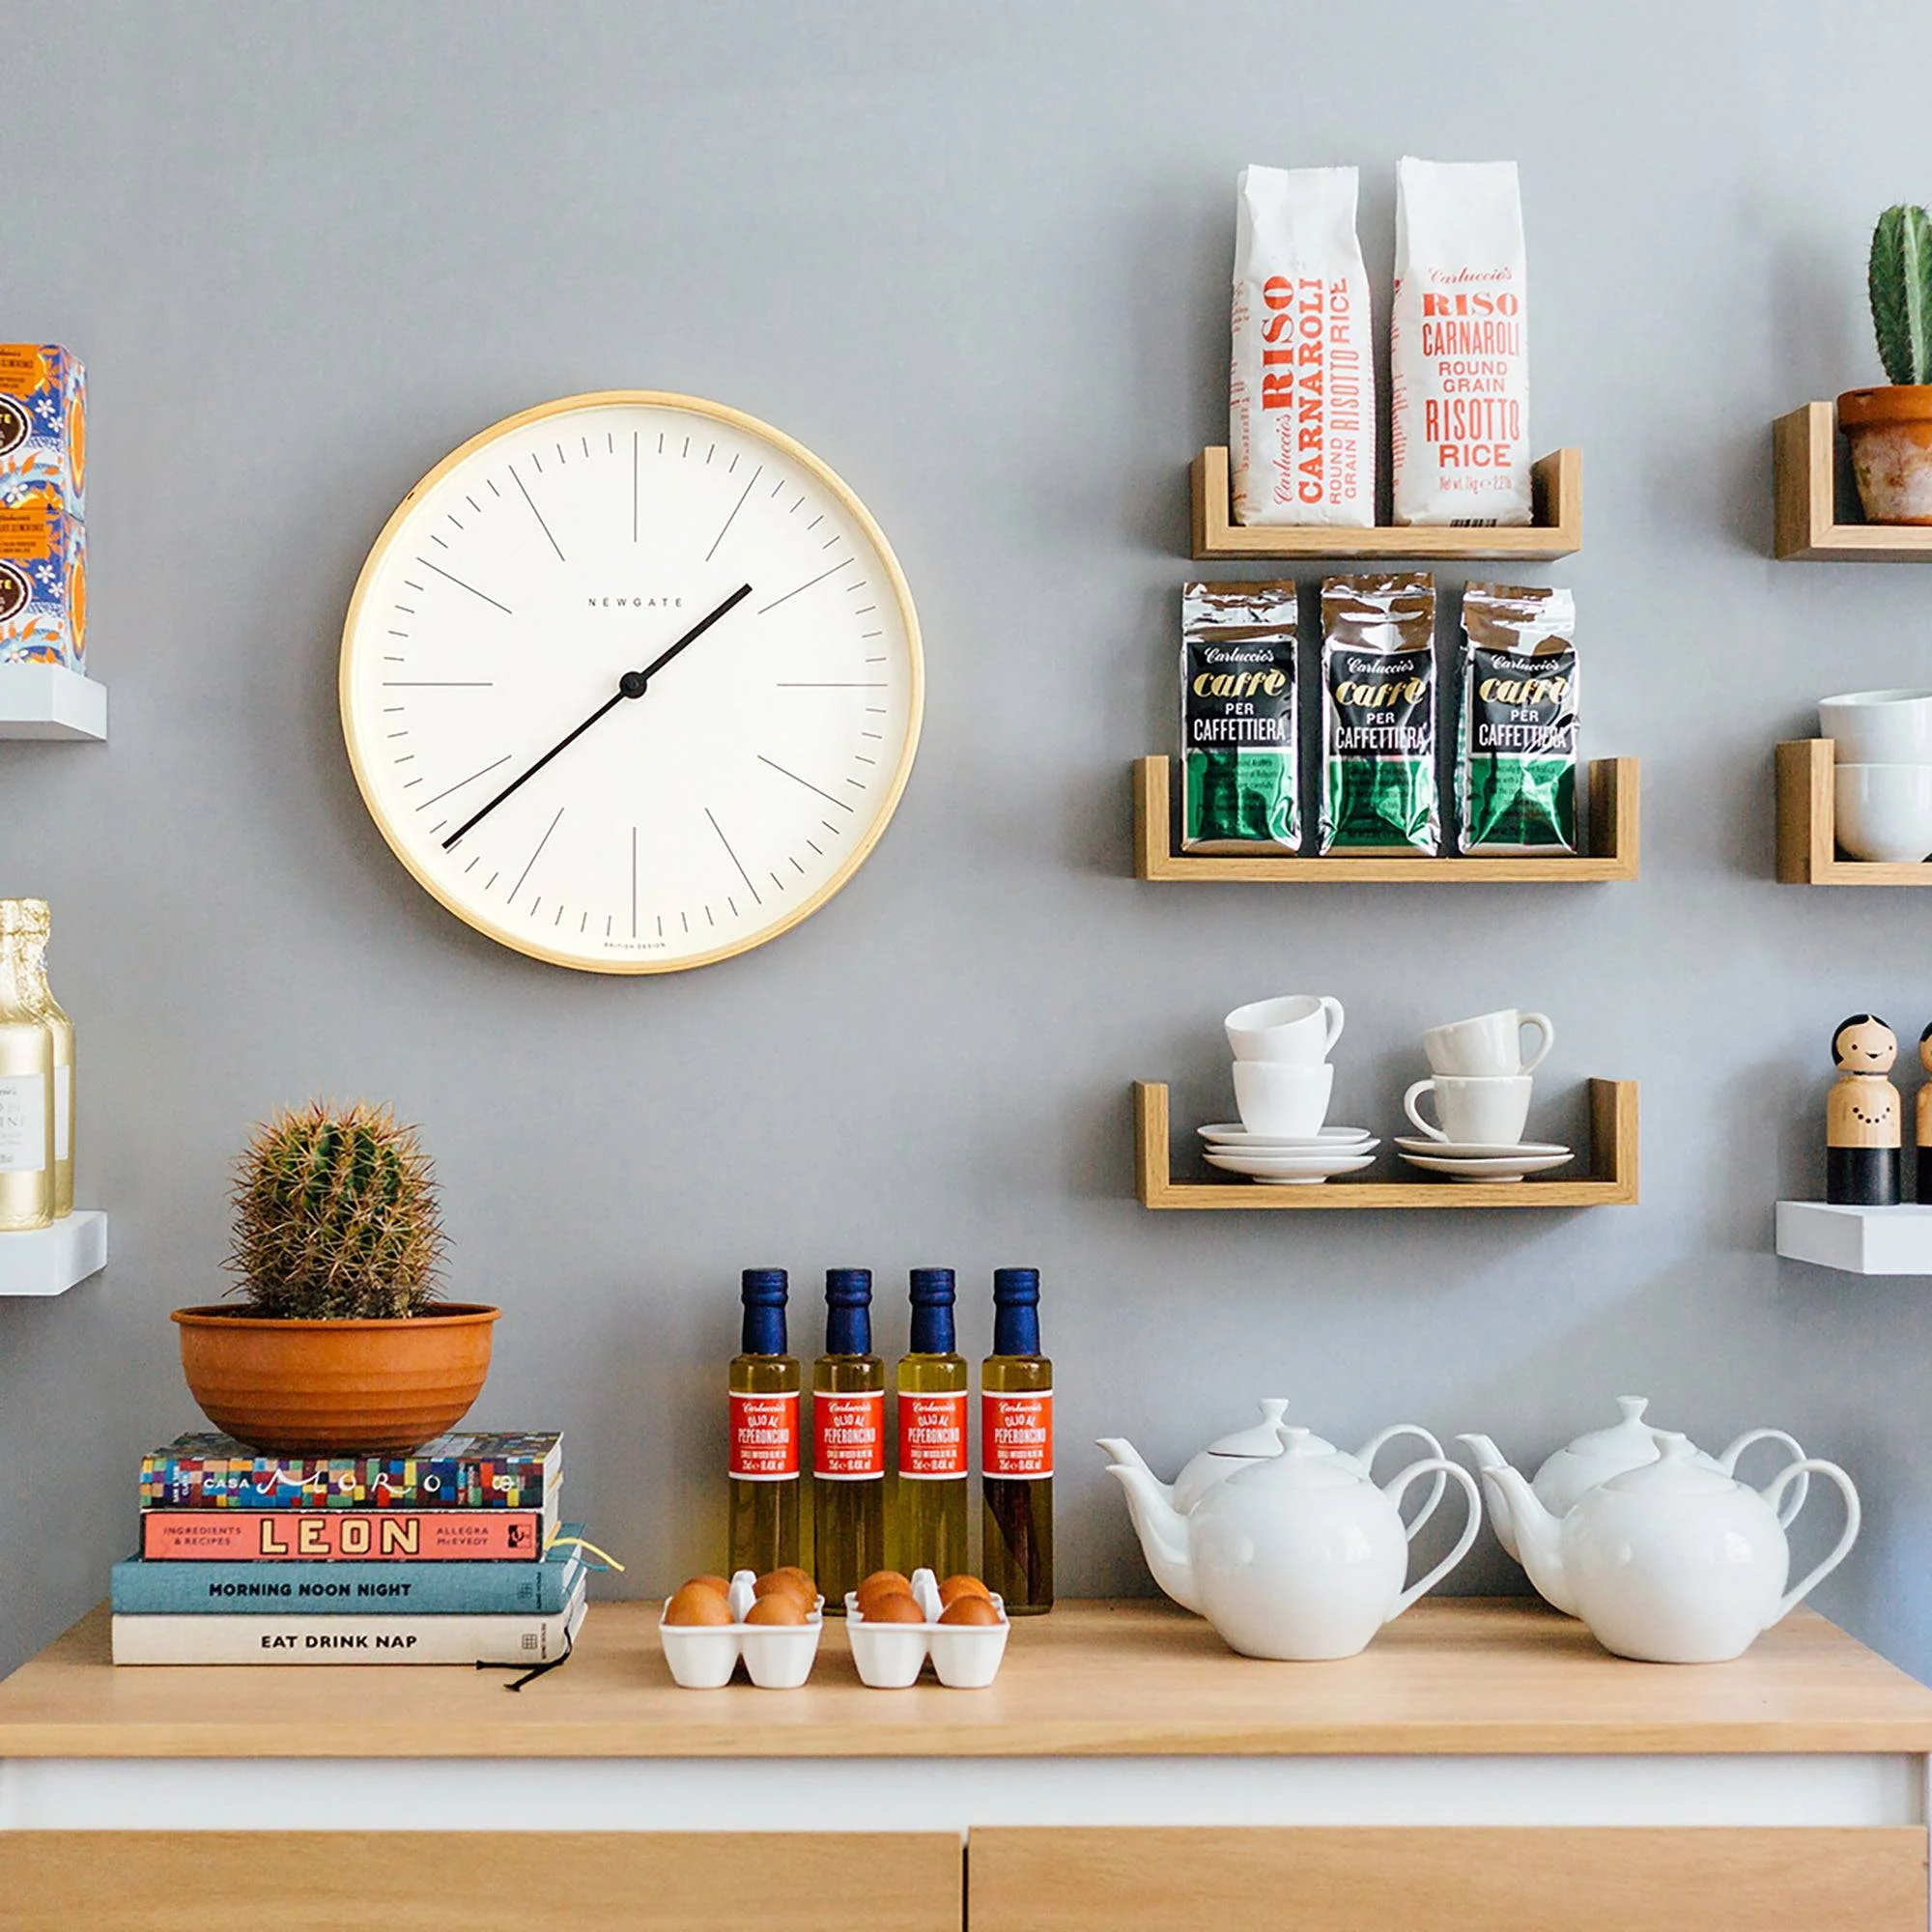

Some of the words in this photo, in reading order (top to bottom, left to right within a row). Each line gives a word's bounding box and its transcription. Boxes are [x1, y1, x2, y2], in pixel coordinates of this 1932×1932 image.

[1428, 267, 1512, 284] Carluccio's
[1329, 278, 1350, 343] RICE
[1423, 292, 1519, 317] RISO
[1261, 275, 1294, 411] RISO
[1422, 321, 1520, 356] CARNAROLI
[1438, 361, 1508, 376] ROUND
[1298, 278, 1323, 503] CARNAROLI
[1330, 350, 1359, 431] RISOTTO
[1443, 378, 1506, 393] GRAIN
[1425, 398, 1520, 441] RISOTTO
[1272, 413, 1293, 504] Carluccio's
[1438, 444, 1512, 468] RICE
[1330, 438, 1343, 504] ROUND
[1345, 439, 1356, 498] GRAIN
[588, 597, 682, 607] NEWGATE
[1204, 646, 1274, 664] Carluccio's
[1347, 657, 1414, 673] Carluccio's
[1491, 654, 1559, 670] Carluccio's
[1193, 668, 1286, 697] caffè
[1335, 676, 1426, 708] caffè
[1479, 676, 1570, 705] caffè
[1225, 703, 1254, 715] PER
[1366, 712, 1395, 724] PER
[1511, 710, 1539, 722] PER
[1194, 719, 1286, 741] CAFFETTIERA
[203, 1478, 250, 1489] CASA
[260, 1518, 419, 1554] LEON
[209, 1583, 292, 1596] MORNING
[298, 1583, 351, 1596] NOON
[357, 1583, 412, 1596] NIGHT
[261, 1635, 298, 1648] EAT
[305, 1635, 368, 1648] DRINK
[376, 1635, 417, 1648] NAP
